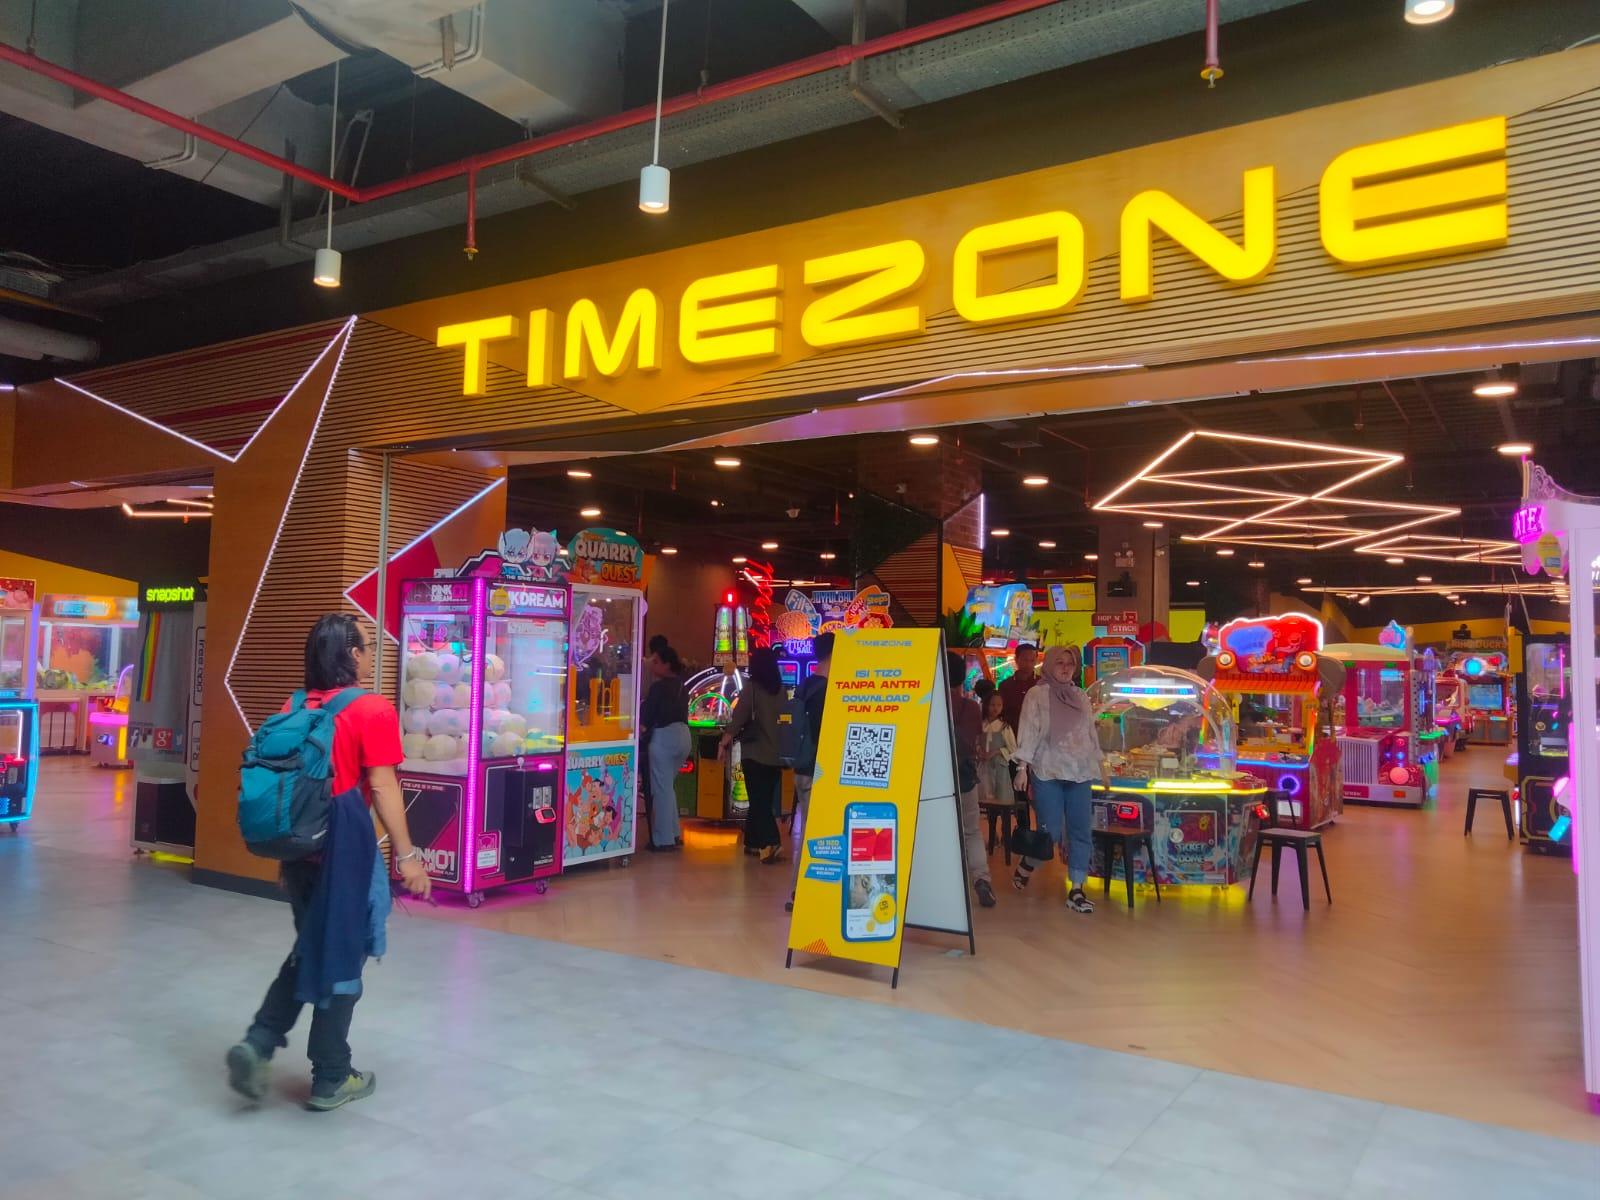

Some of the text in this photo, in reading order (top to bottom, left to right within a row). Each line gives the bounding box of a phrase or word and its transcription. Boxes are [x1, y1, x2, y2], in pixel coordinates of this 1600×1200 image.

[436, 115, 1510, 397] TIMEZONE
[575, 539, 638, 562] QUARRY
[602, 563, 638, 583] QUEST
[146, 586, 195, 603] snapshot
[432, 584, 452, 596] PINK
[855, 669, 902, 678] ISI TIZO
[836, 680, 920, 689] TANPA ANTRI
[842, 694, 910, 703] DOWNLOAD
[847, 705, 899, 713] FUN APP
[1175, 842, 1205, 853] TICKET
[1178, 854, 1205, 864] DOME
